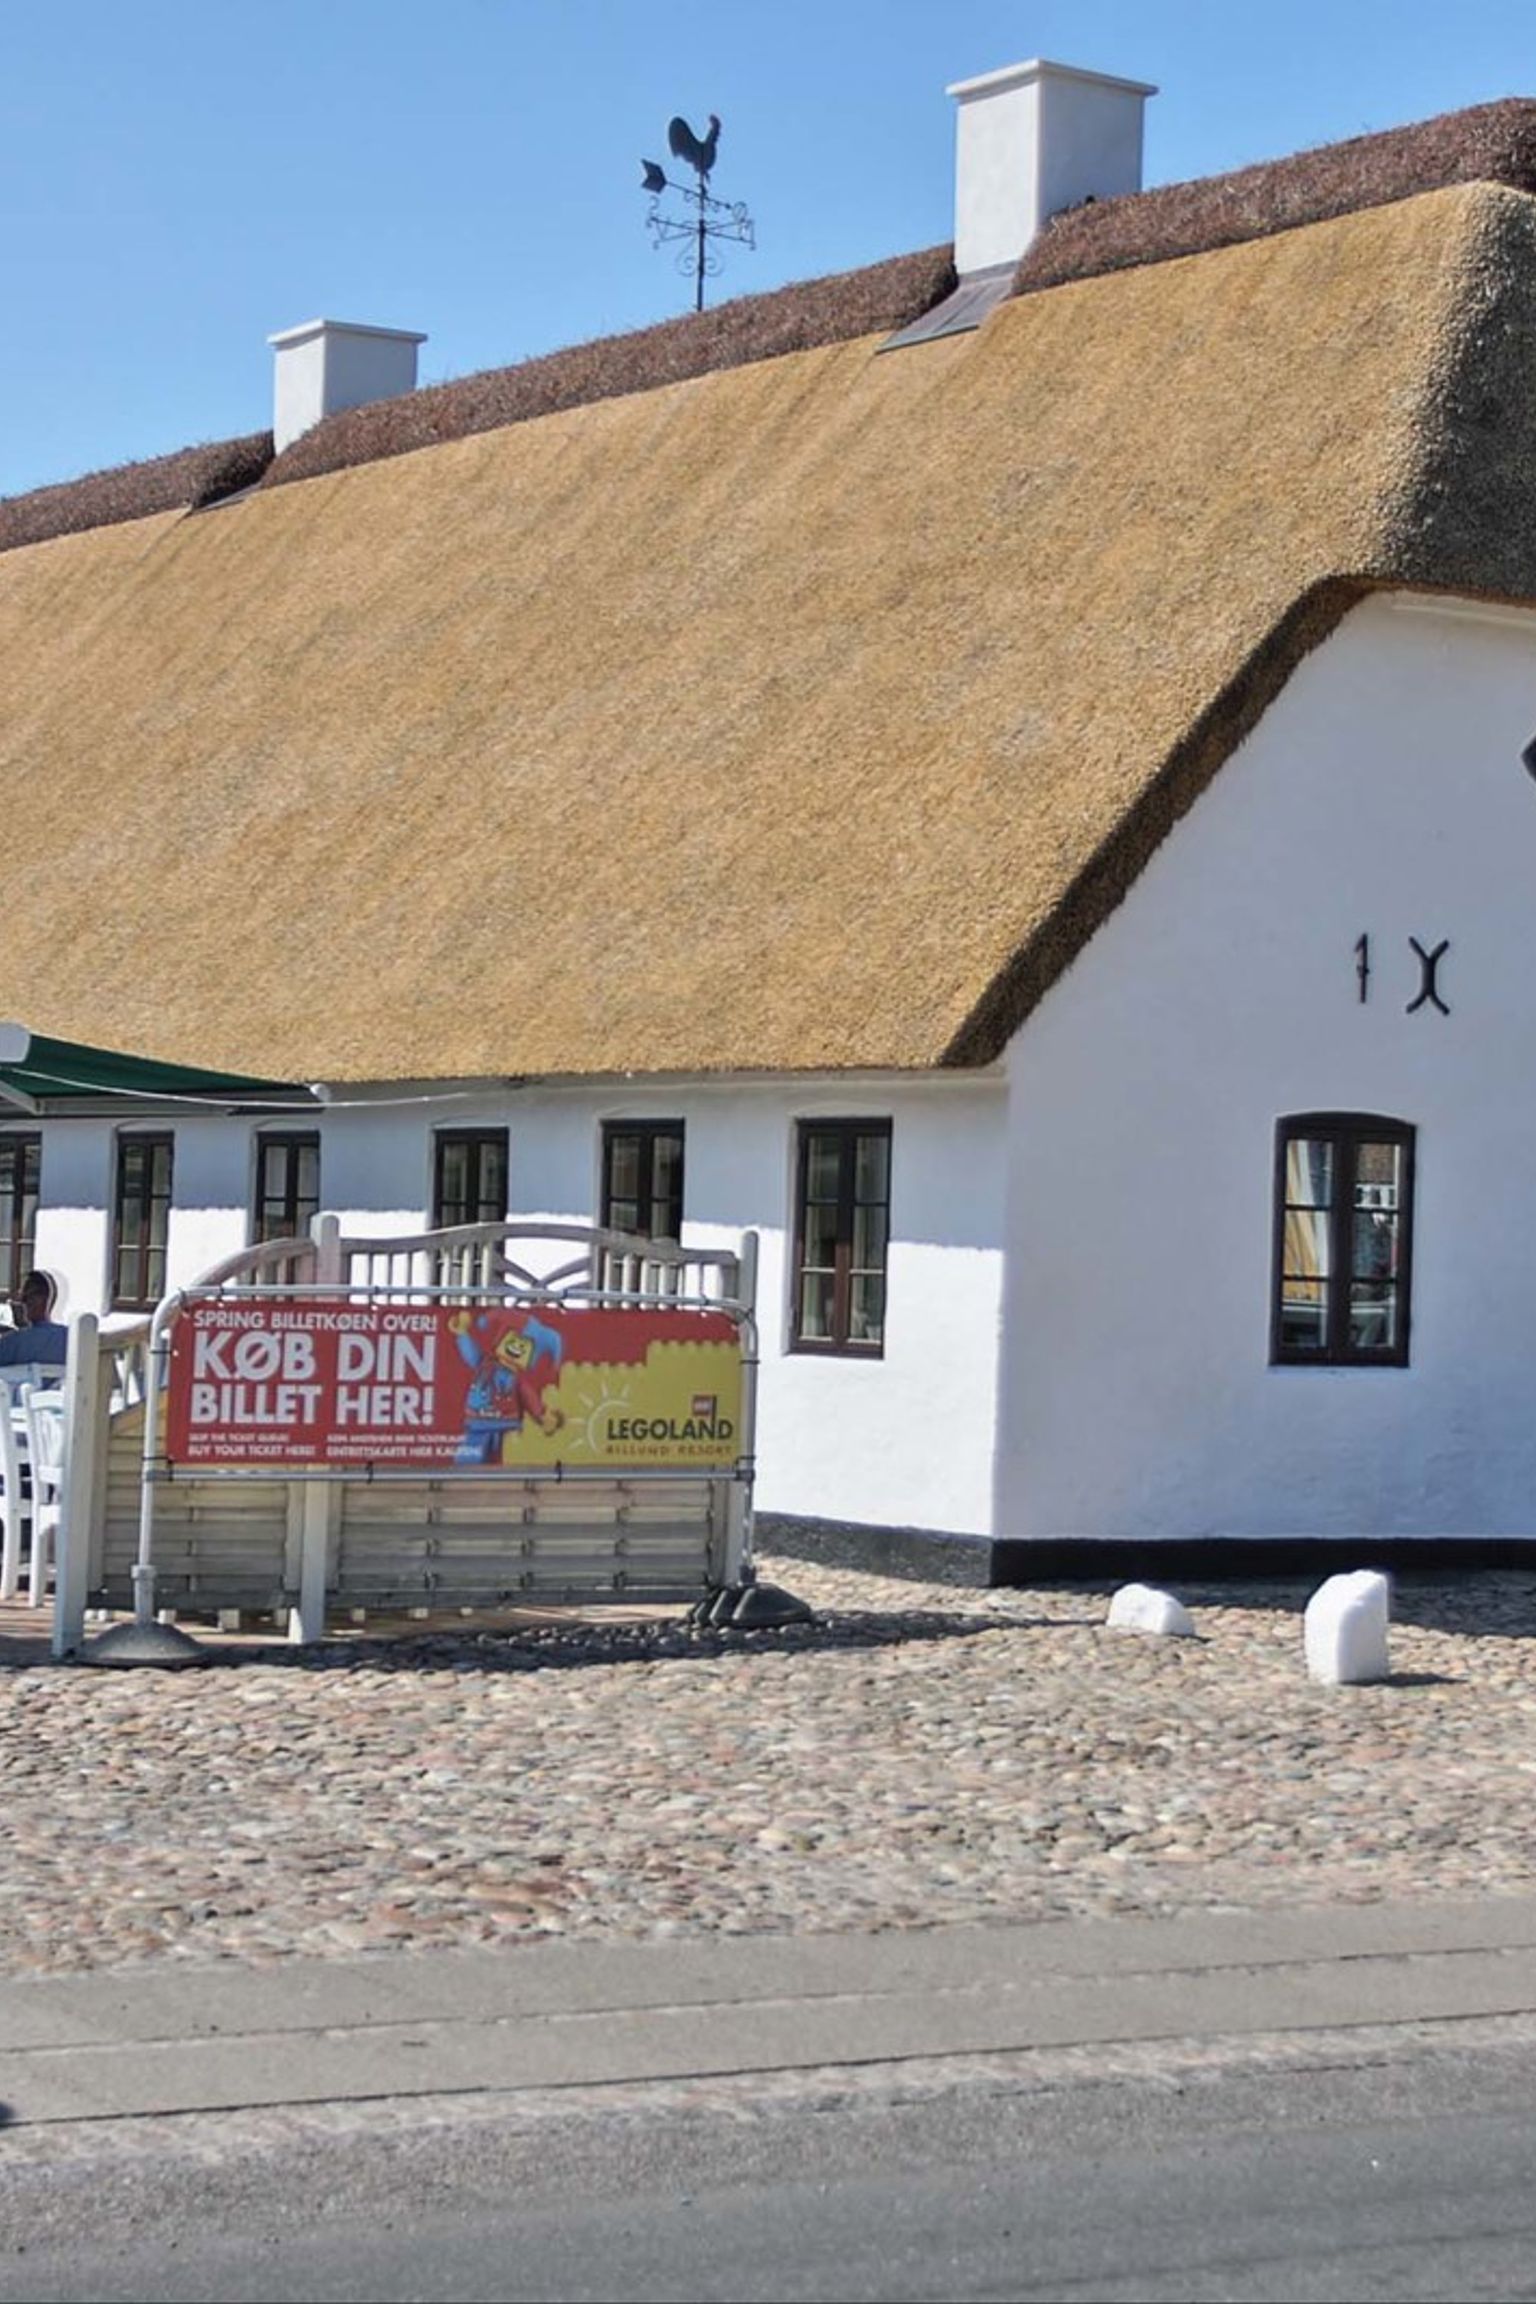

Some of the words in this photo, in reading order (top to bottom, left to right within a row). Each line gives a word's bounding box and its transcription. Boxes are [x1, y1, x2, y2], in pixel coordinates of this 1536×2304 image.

[194, 1310, 265, 1328] SPRING
[271, 1311, 378, 1331] BILLETKØEN
[383, 1314, 437, 1331] OVER!
[193, 1330, 316, 1381] KØB
[337, 1332, 436, 1382] DIN
[190, 1383, 322, 1424] BILLET
[336, 1385, 434, 1426] HER!
[607, 1418, 733, 1440] LEGOLAND
